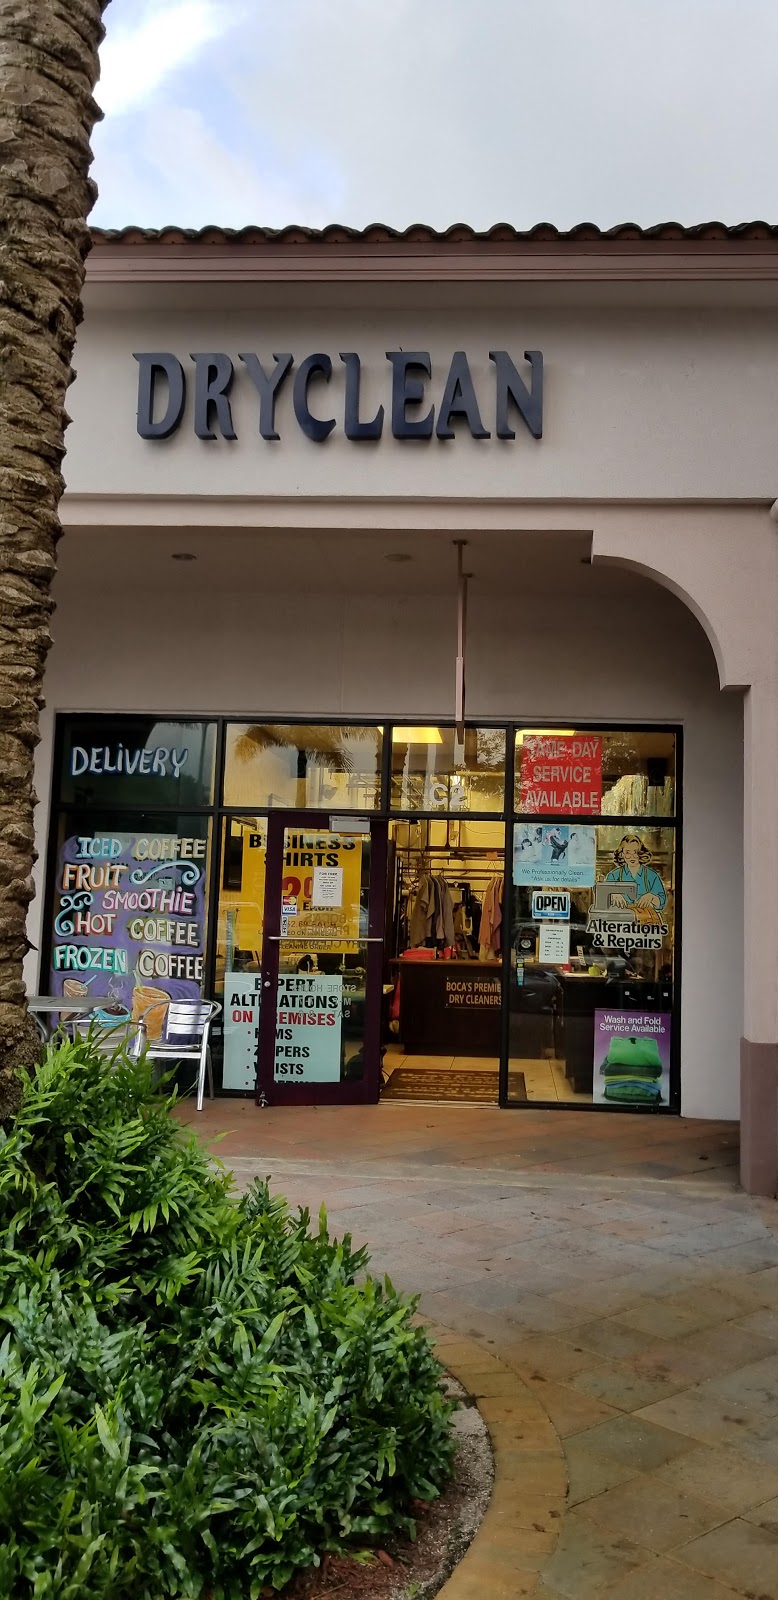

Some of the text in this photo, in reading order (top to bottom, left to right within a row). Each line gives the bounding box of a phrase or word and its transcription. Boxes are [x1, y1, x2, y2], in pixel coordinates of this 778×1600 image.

[132, 351, 543, 441] DRYCLEAN
[533, 765, 591, 783] SERVICE
[430, 783, 464, 806] C2
[525, 790, 599, 808] AVAILABLE
[76, 837, 206, 860] ICED COFFEE
[250, 834, 356, 850] BINESS
[264, 852, 339, 867] HIRTS
[532, 868, 567, 877] Professionally
[536, 895, 567, 911] OPEN
[75, 912, 116, 935] HOT
[586, 918, 668, 935] Alterations
[130, 918, 199, 947] COFFEE
[594, 934, 662, 953] & Repairs
[54, 945, 204, 980] FROZEN COFFEE
[255, 978, 315, 992] EPERT
[446, 981, 502, 993] BOCA'S PREMIE
[230, 993, 338, 1008] ALTATIONS
[449, 994, 464, 1004] DRY
[232, 1009, 336, 1026] ON EMISES
[604, 1015, 661, 1025] Wash and Fold
[600, 1023, 666, 1033] Service Available
[254, 1045, 310, 1058] ZPERS
[254, 1062, 304, 1075] ISTS
